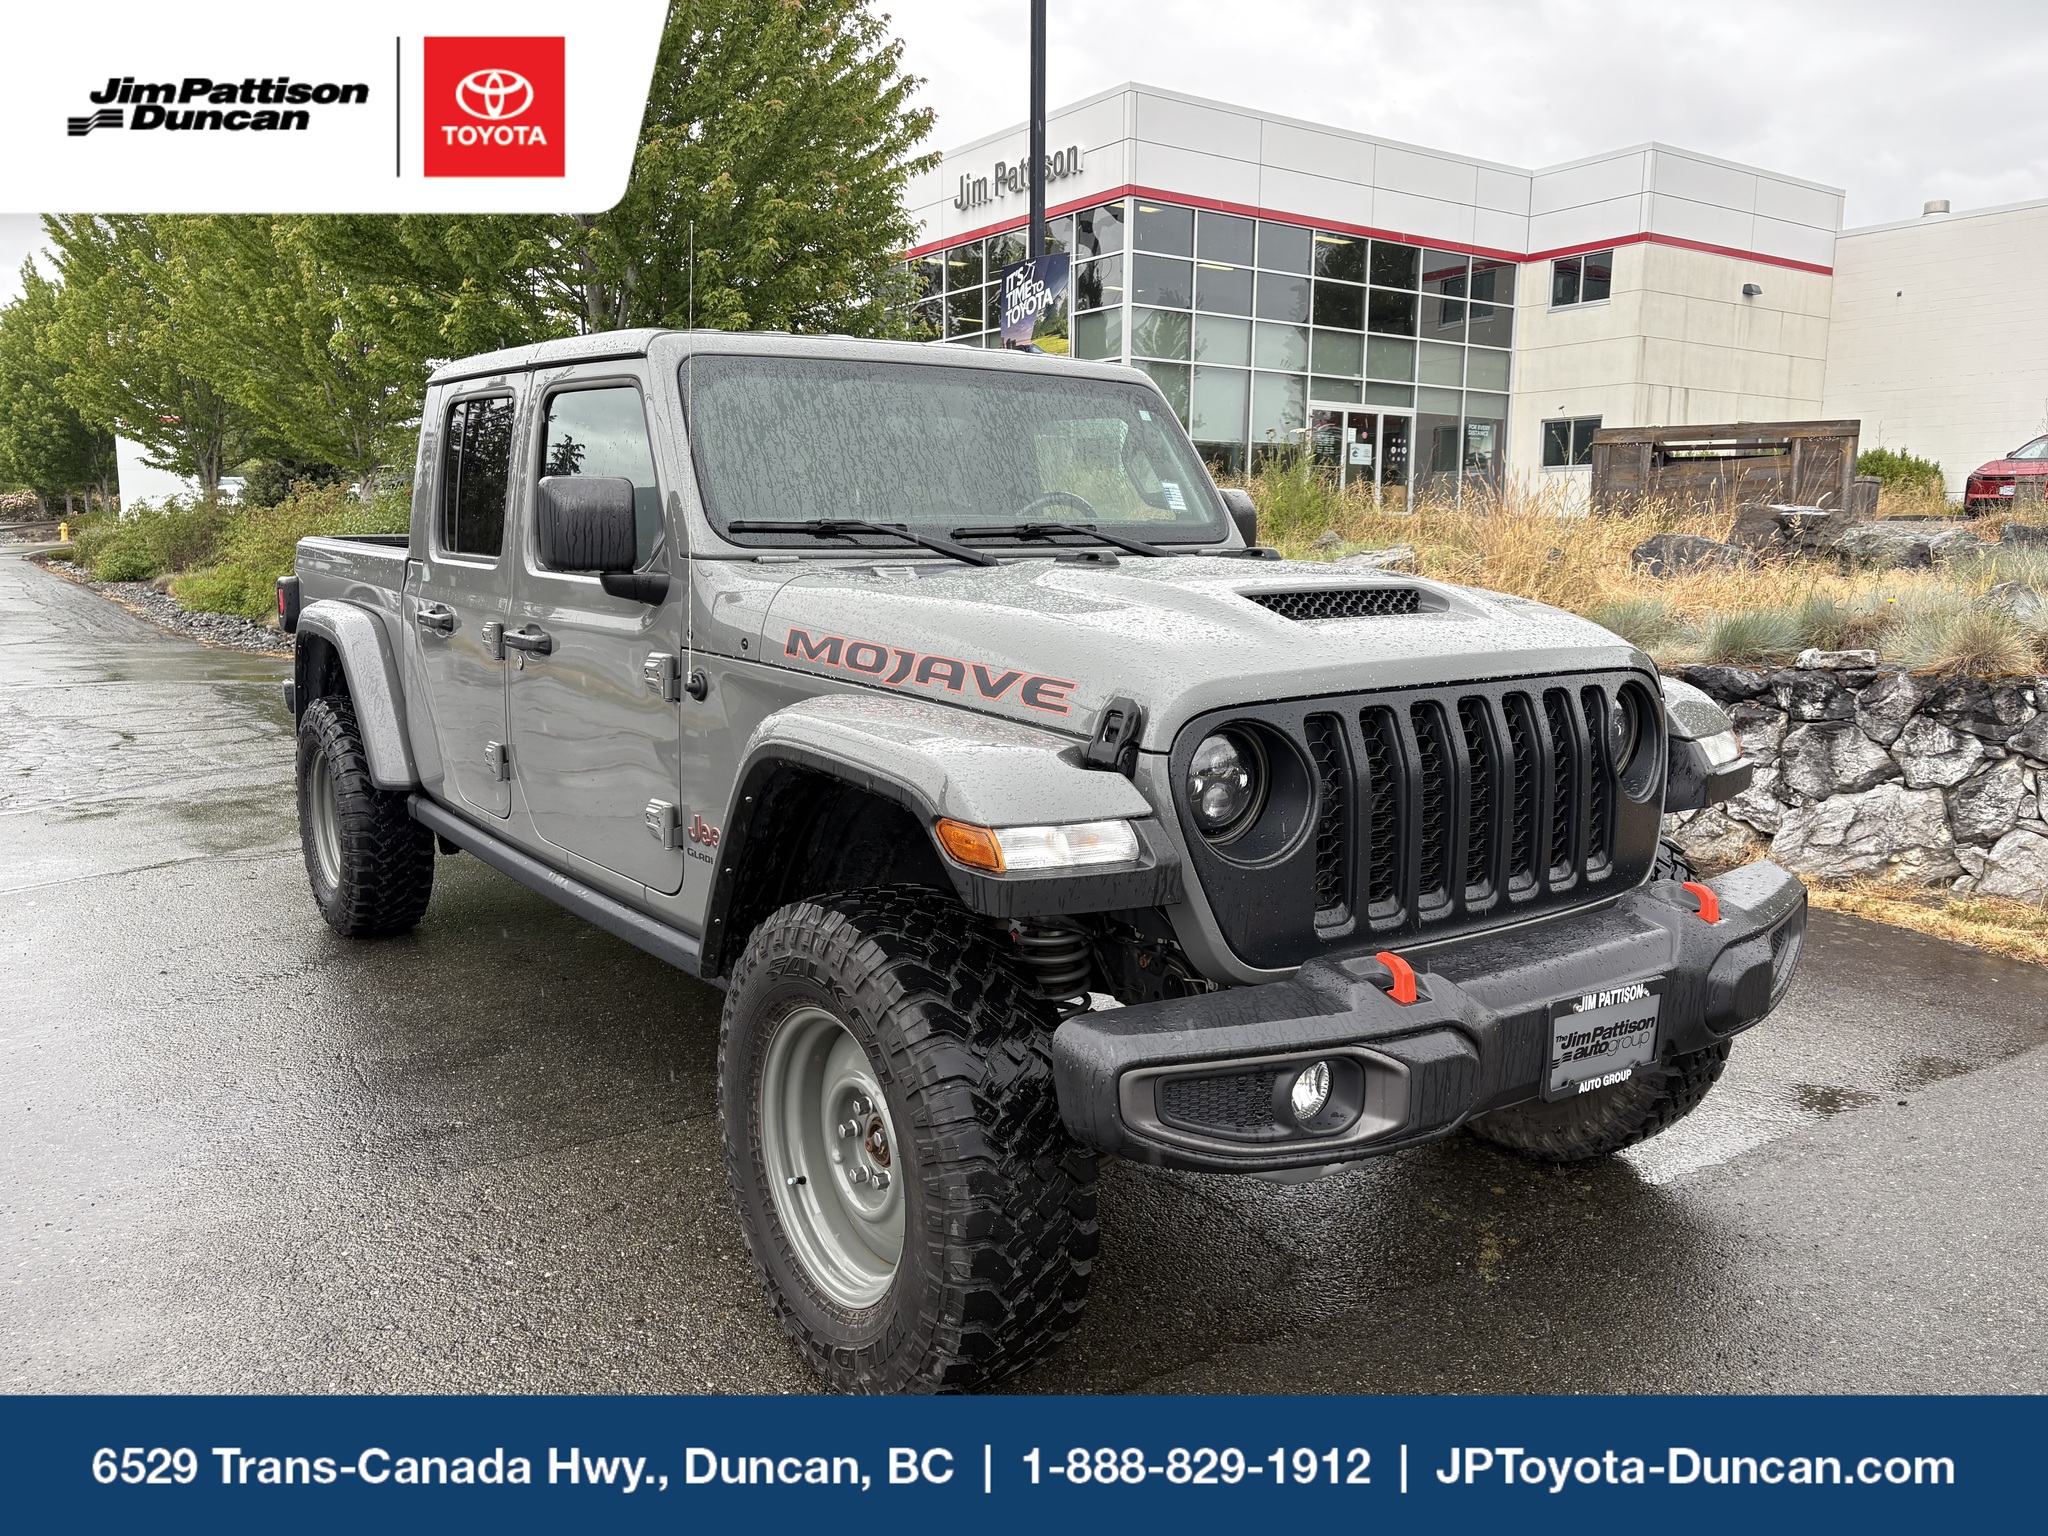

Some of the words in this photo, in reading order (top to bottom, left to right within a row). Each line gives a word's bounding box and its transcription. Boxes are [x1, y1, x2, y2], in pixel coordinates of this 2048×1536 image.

[954, 173, 993, 211] Jim
[1006, 266, 1024, 294] IT'S
[1006, 279, 1032, 310] TIME
[1032, 280, 1044, 295] TO
[1005, 287, 1053, 328] TOYOTA
[784, 627, 1078, 716] MOJAVE
[687, 814, 721, 849] Jee
[687, 847, 714, 865] GLADI
[1578, 993, 1597, 1013] JIM
[1598, 983, 1644, 1008] PATTISON
[1555, 1034, 1569, 1043] The
[1578, 1080, 1602, 1094] AUTO
[1603, 1068, 1632, 1087] GROUP
